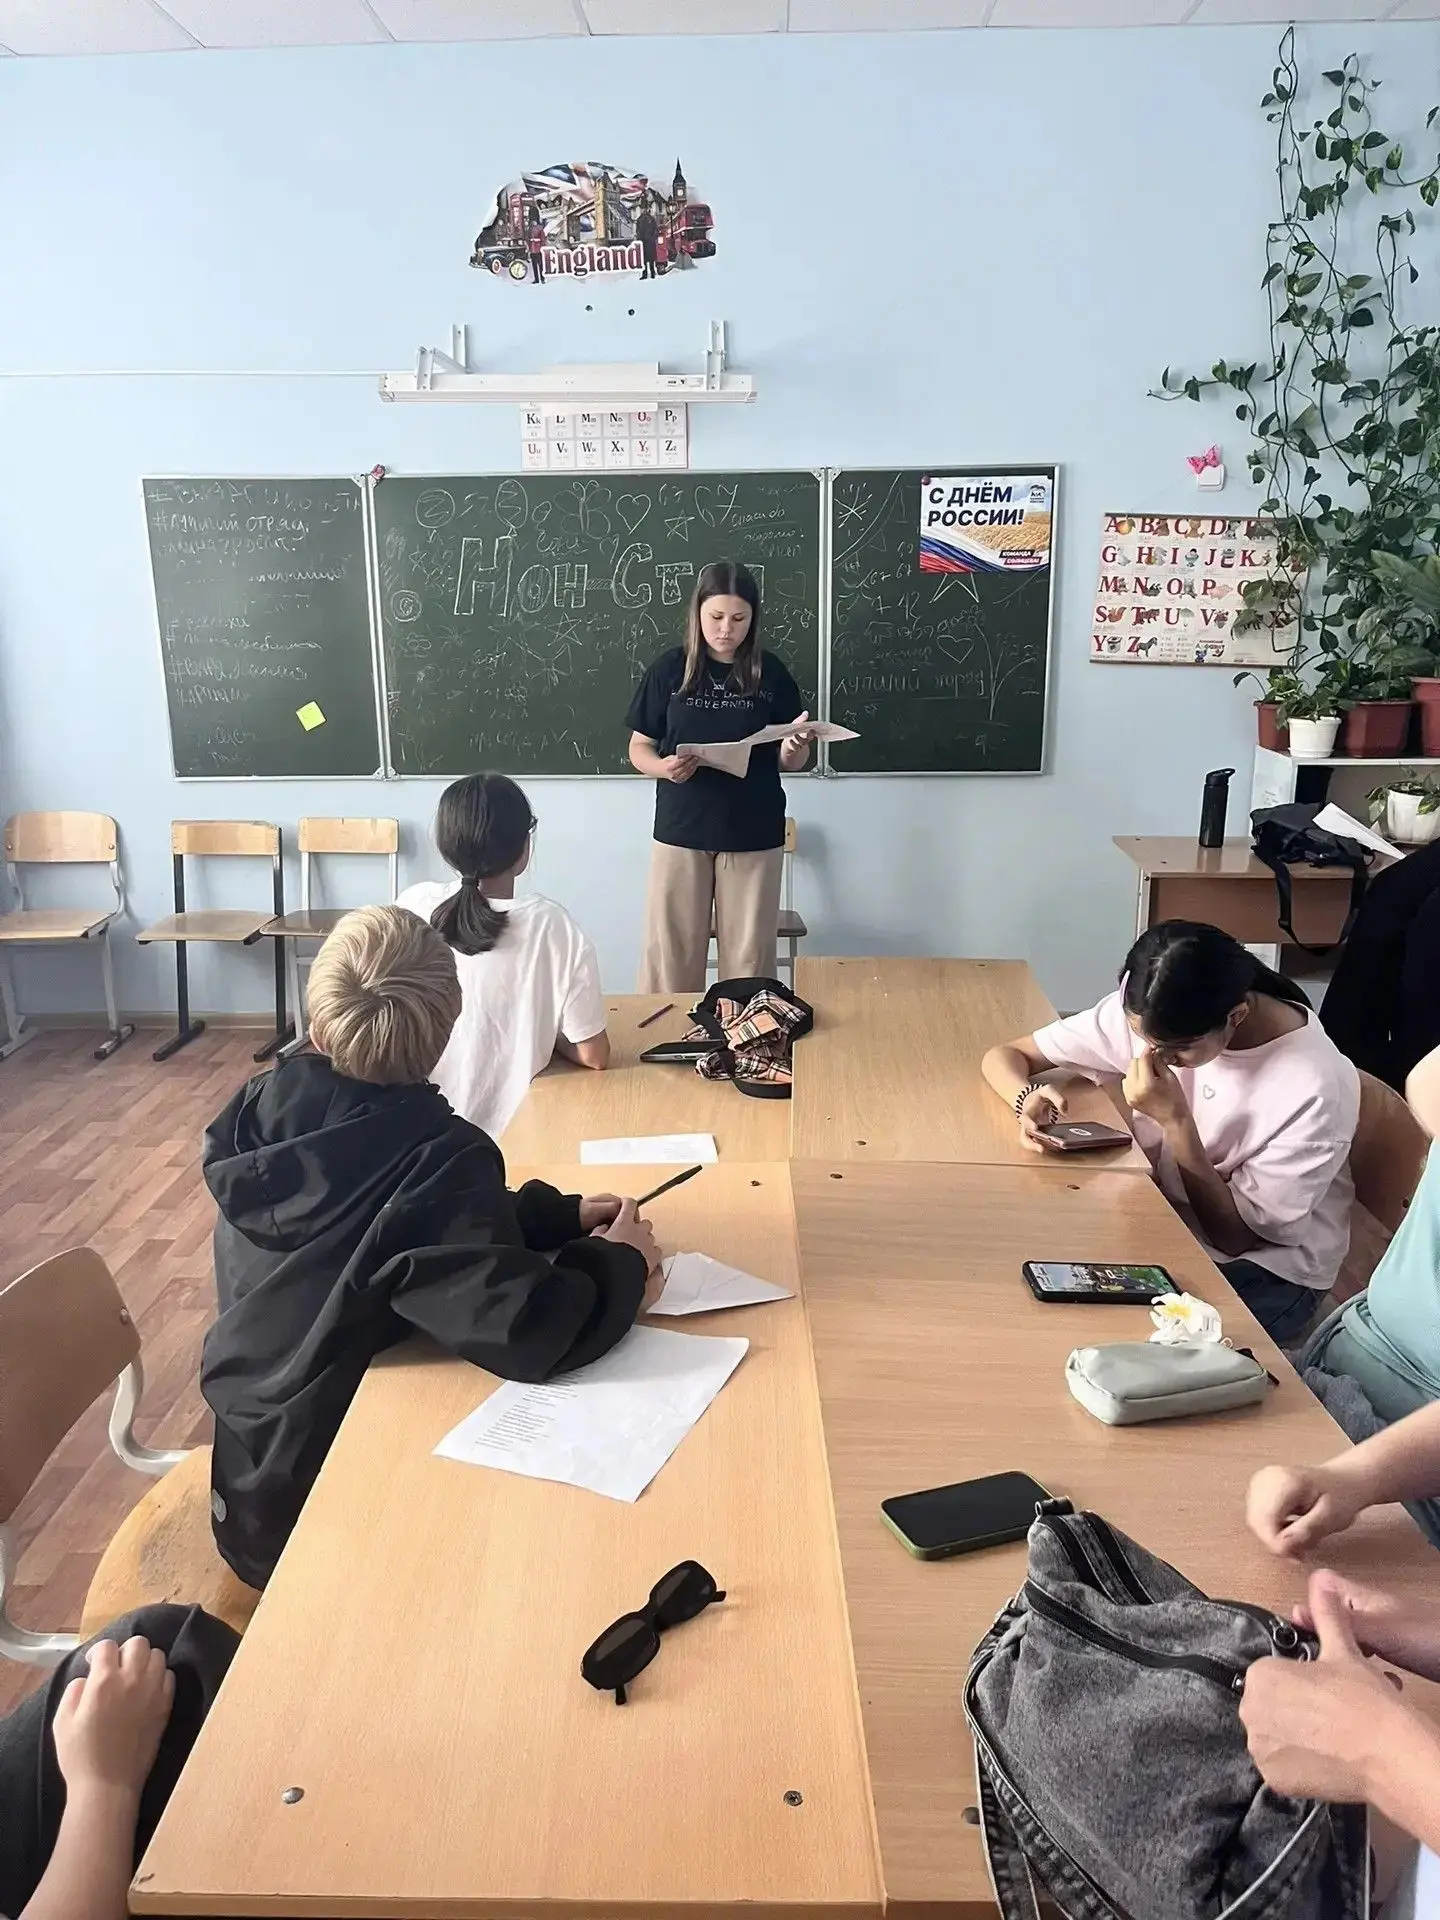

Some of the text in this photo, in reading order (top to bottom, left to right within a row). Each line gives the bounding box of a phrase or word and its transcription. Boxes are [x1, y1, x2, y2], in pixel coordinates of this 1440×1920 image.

[543, 243, 642, 277] England
[526, 413, 541, 425] Kk
[581, 413, 597, 423] Mm
[665, 409, 678, 423] Pp
[528, 440, 677, 455] Uu Vv Ww Xx Yy Zz
[929, 481, 1013, 508] С ДНЁМ
[927, 508, 1025, 527] РОССИИ!
[1139, 517, 1156, 533] B
[1174, 518, 1189, 535] C
[1208, 519, 1227, 536] D
[1102, 545, 1260, 567] G H I J K
[1098, 576, 1217, 596] M N O P
[1095, 605, 1108, 623] S
[1131, 606, 1146, 626] T
[1164, 607, 1182, 625] U
[1200, 608, 1216, 626] V
[1093, 635, 1107, 652] Y
[1127, 636, 1141, 653] Z
[686, 697, 755, 711] GOVERNOR
